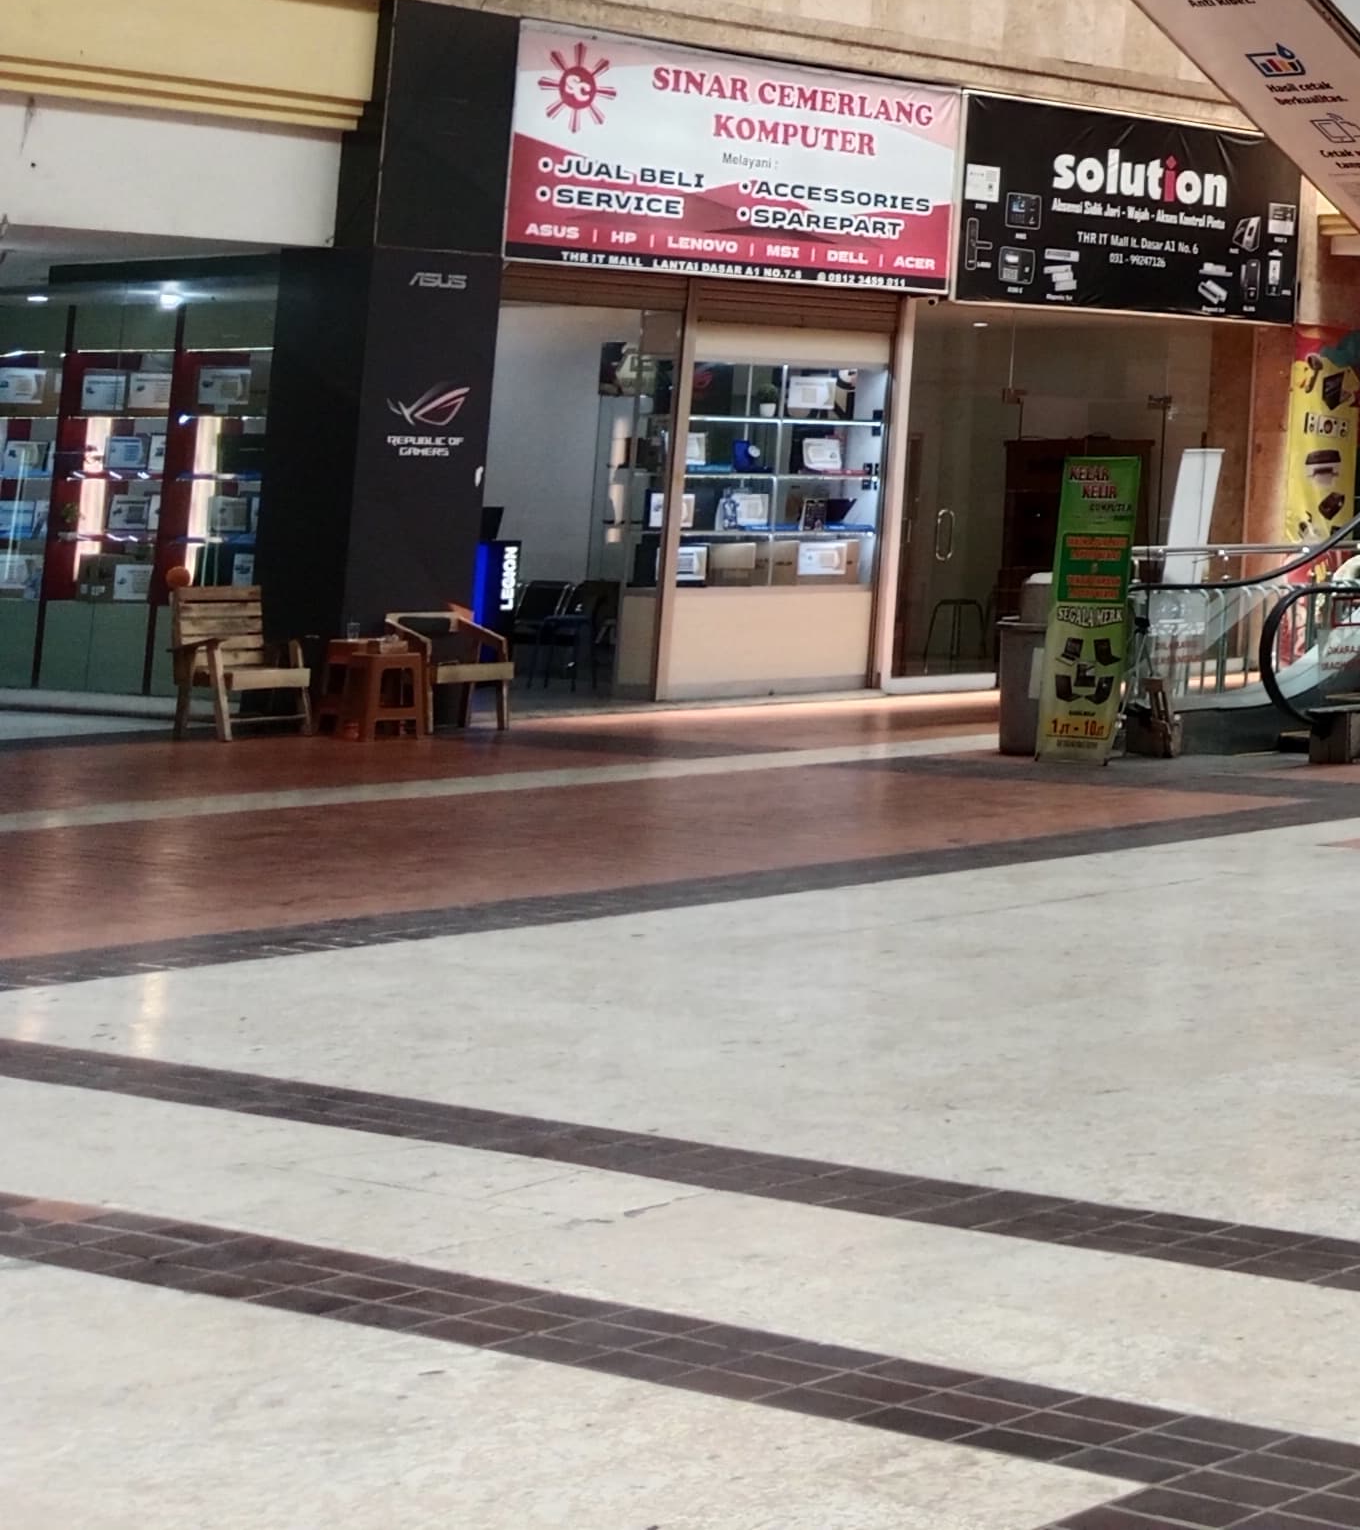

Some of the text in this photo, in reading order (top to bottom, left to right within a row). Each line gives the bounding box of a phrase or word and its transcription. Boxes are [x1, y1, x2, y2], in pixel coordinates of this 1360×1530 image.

[652, 66, 934, 127] SINAR CEMERLANG
[713, 114, 877, 156] KOMPUTER
[556, 157, 706, 189] JUAL BELI
[721, 152, 773, 170] Melayani
[1052, 147, 1228, 207] solution
[555, 188, 684, 216] SERVICE
[754, 180, 931, 212] ACCESSORIES
[753, 208, 903, 238] SPAREPART
[525, 222, 936, 271] ASUS HP LENOVO MSI DELL ACER
[409, 272, 467, 289] ASUS
[387, 435, 464, 446] REPUBLIC OF
[399, 447, 449, 457] GAMERS
[500, 546, 518, 611] LEGION
